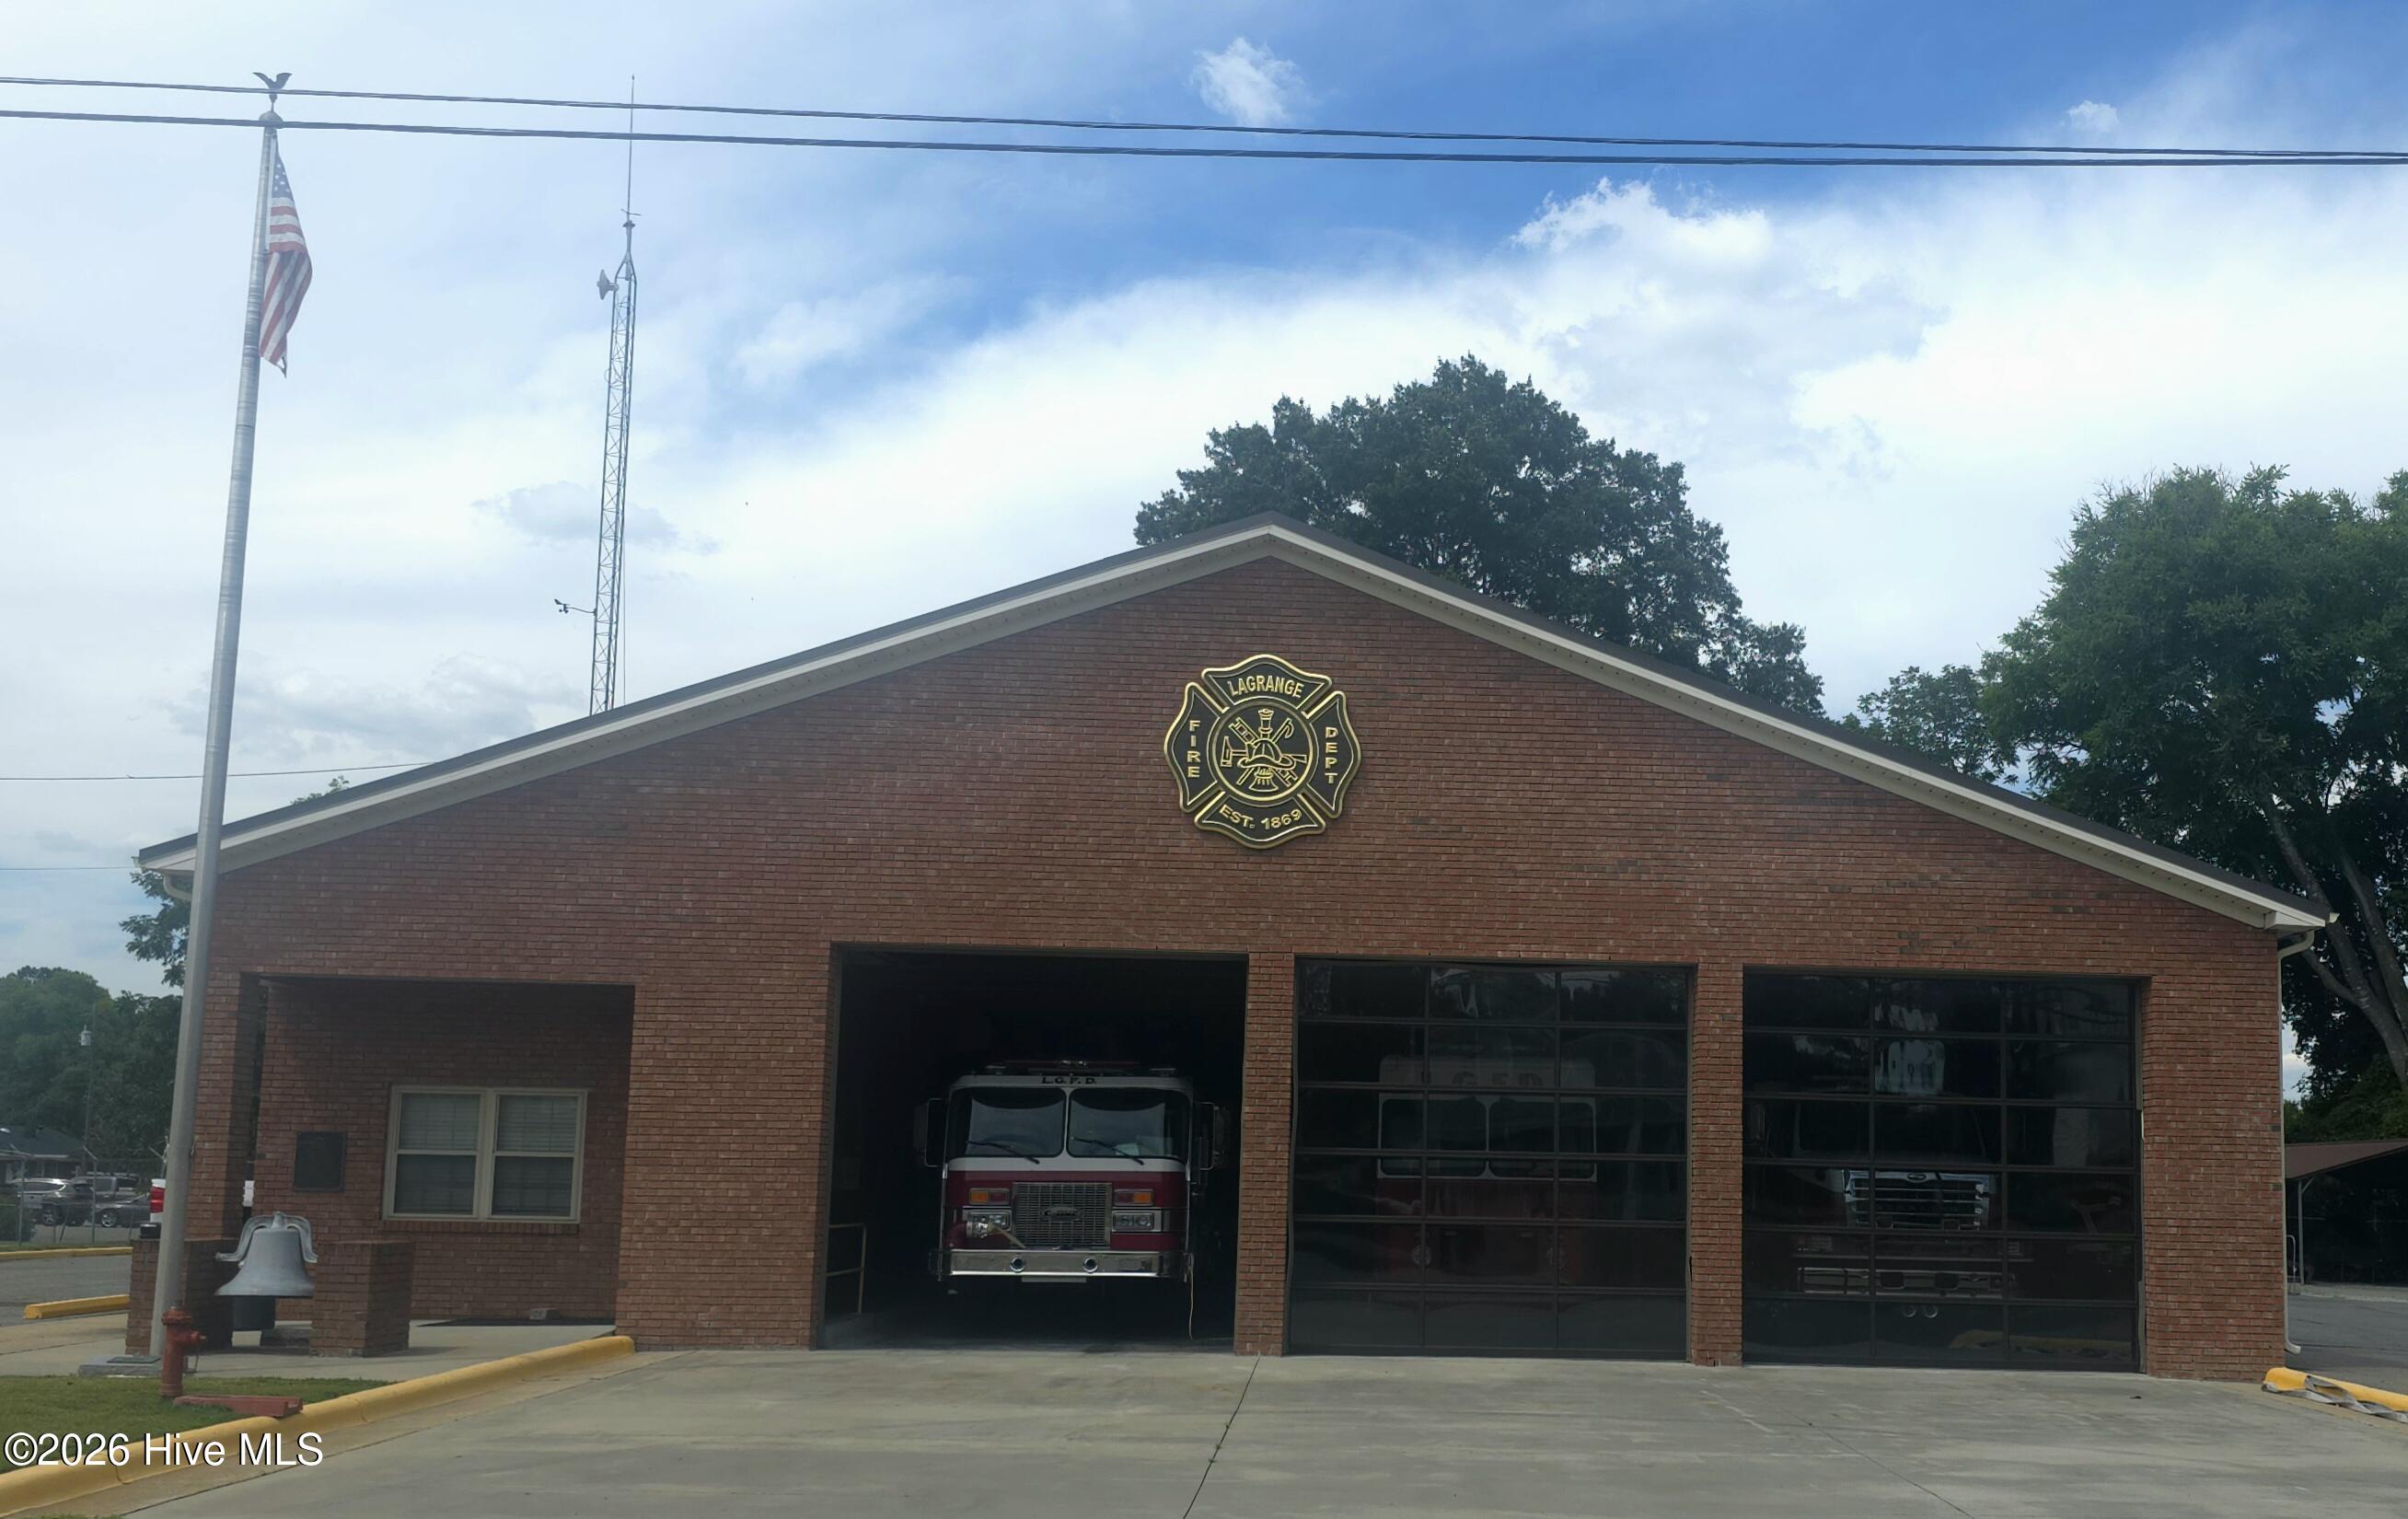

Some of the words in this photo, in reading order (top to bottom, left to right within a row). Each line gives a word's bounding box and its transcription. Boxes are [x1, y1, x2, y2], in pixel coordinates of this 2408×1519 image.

[1228, 675, 1305, 698] LAGRANGE
[1187, 720, 1201, 778] FIRE
[1324, 726, 1338, 784] DEPT
[1219, 804, 1256, 829] EST.
[1260, 808, 1302, 829] 1869
